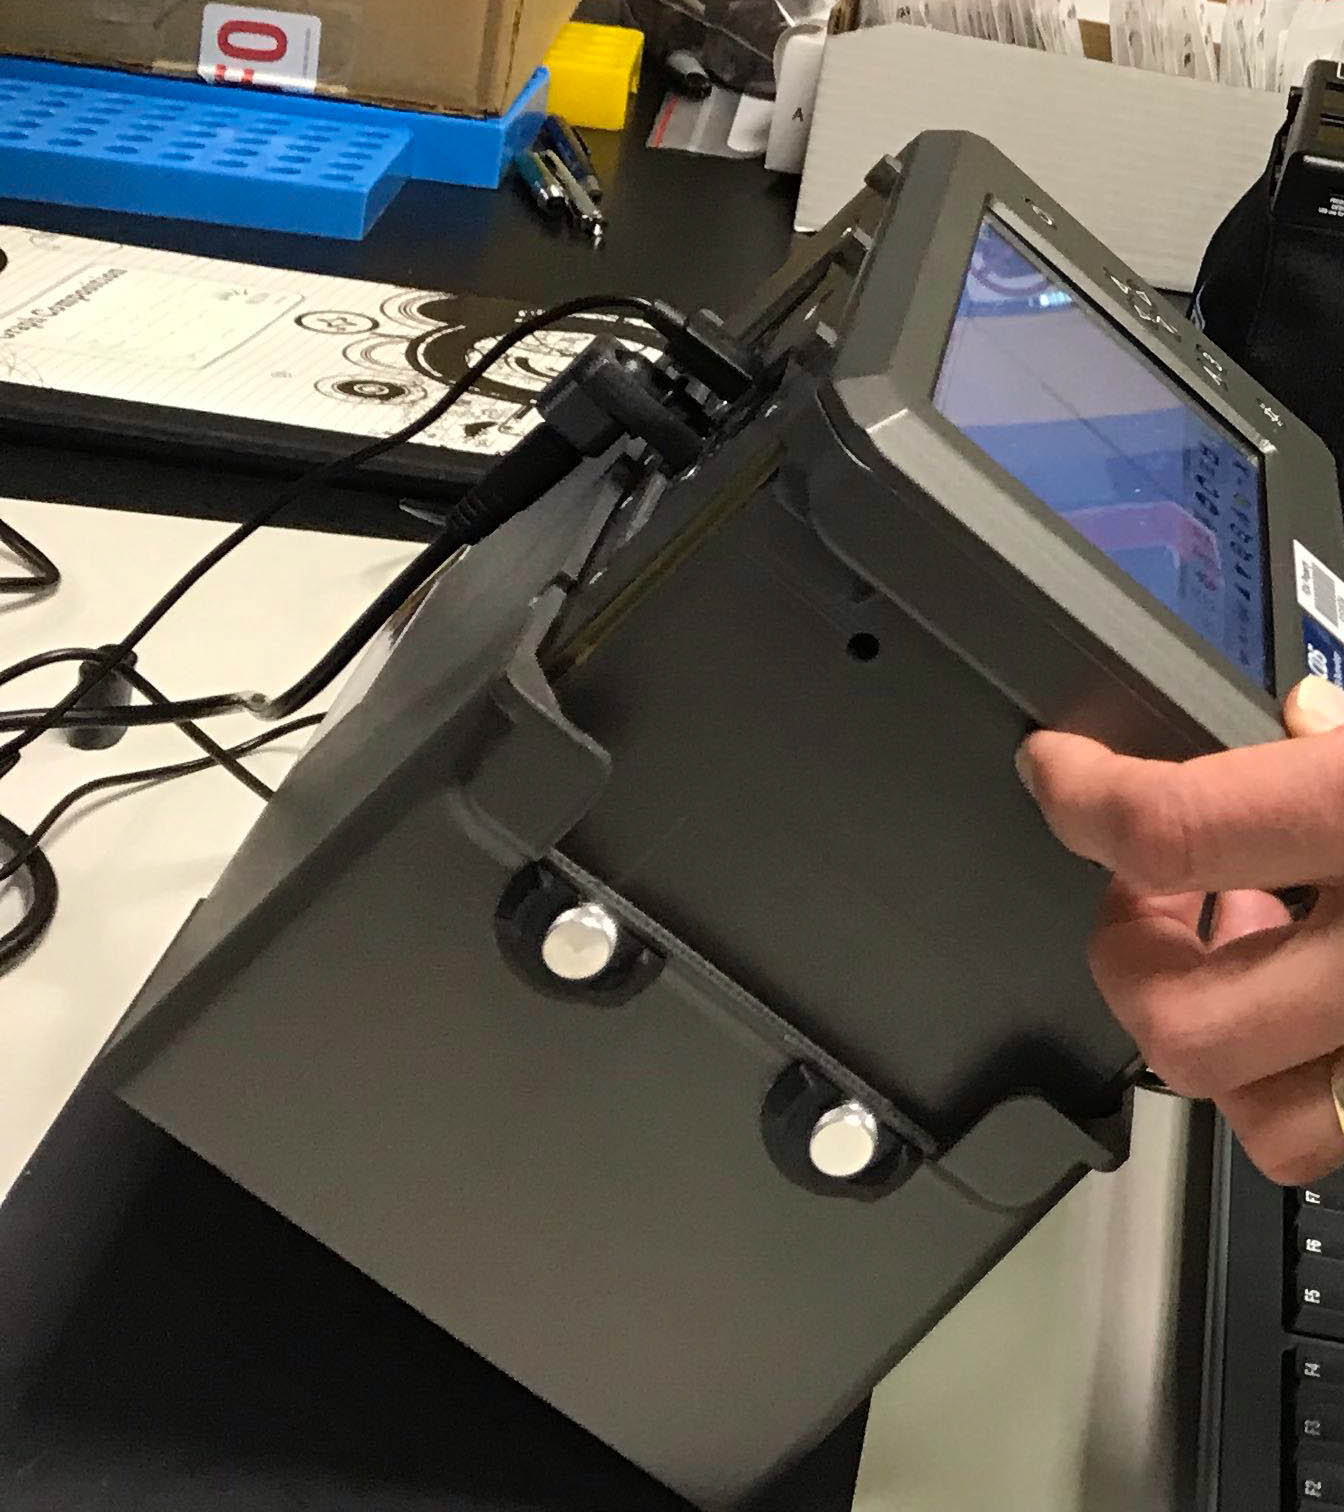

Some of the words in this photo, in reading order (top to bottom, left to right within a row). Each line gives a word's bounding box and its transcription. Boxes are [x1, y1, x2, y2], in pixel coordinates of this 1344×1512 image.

[792, 107, 804, 122] A
[1306, 1191, 1320, 1203] F7
[1306, 1239, 1321, 1252] F6
[1305, 1289, 1320, 1303] F5
[1305, 1363, 1320, 1377] F4
[1304, 1420, 1320, 1435] F3
[1305, 1480, 1321, 1497] F2
